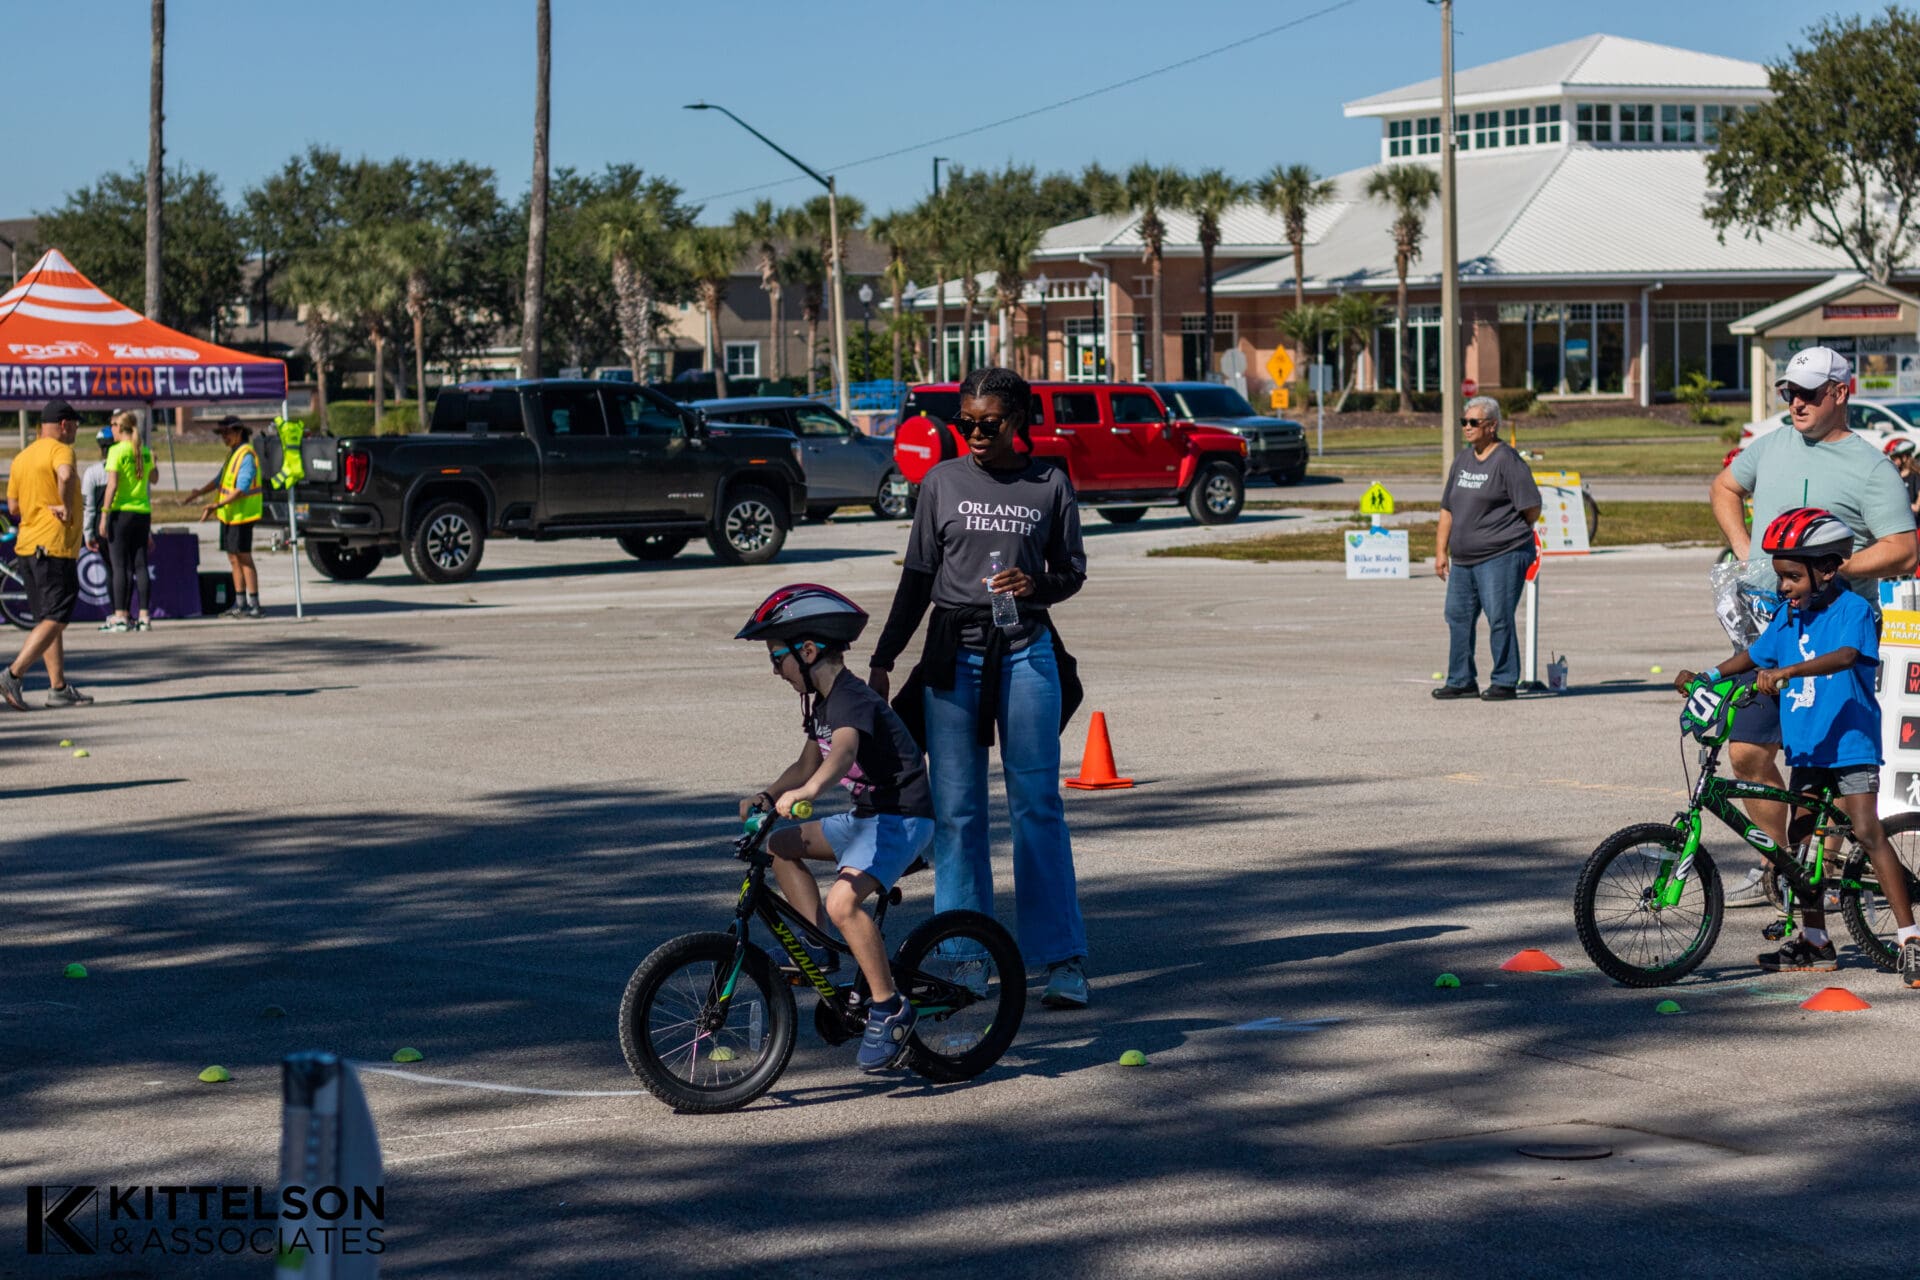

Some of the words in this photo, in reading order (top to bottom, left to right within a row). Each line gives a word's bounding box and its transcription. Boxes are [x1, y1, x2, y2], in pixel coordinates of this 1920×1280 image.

[0, 365, 245, 396] TARGETZEROFL.COM
[957, 500, 1042, 522] ORLANDO
[1911, 663, 1920, 677] D
[1909, 679, 1920, 692] W
[771, 922, 836, 997] SPECIALIZED
